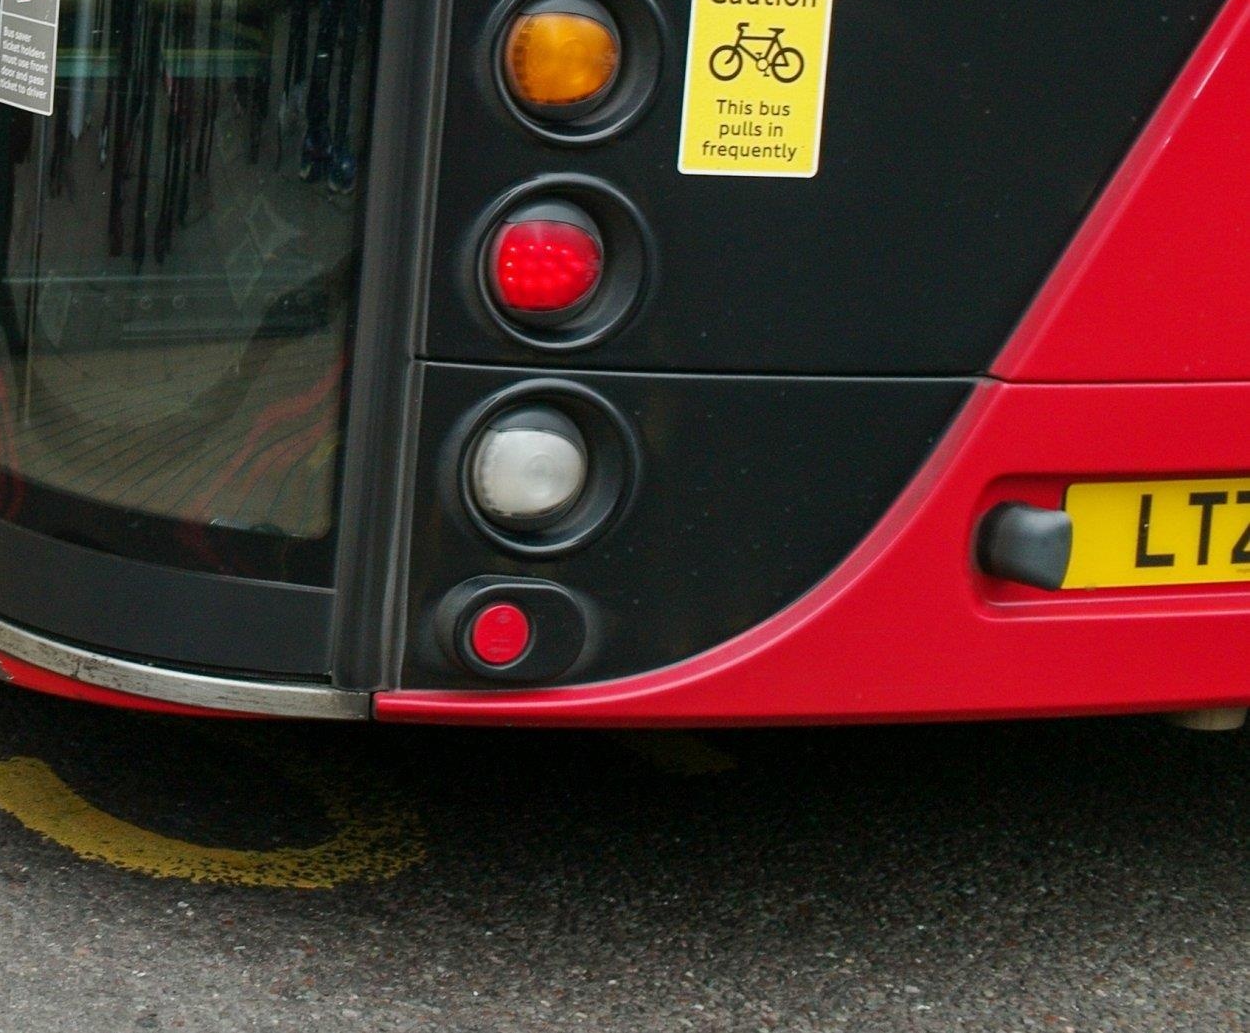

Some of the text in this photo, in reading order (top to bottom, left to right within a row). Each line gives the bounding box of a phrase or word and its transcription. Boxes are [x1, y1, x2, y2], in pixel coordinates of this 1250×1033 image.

[3, 26, 32, 43] Bus saver
[2, 40, 46, 60] ticket holders
[1, 54, 48, 74] must use front
[0, 66, 45, 86] door and pass
[0, 78, 48, 100] ticket to driver
[716, 99, 790, 117] This bus
[719, 120, 784, 139] pulls in
[702, 141, 798, 162] frequently
